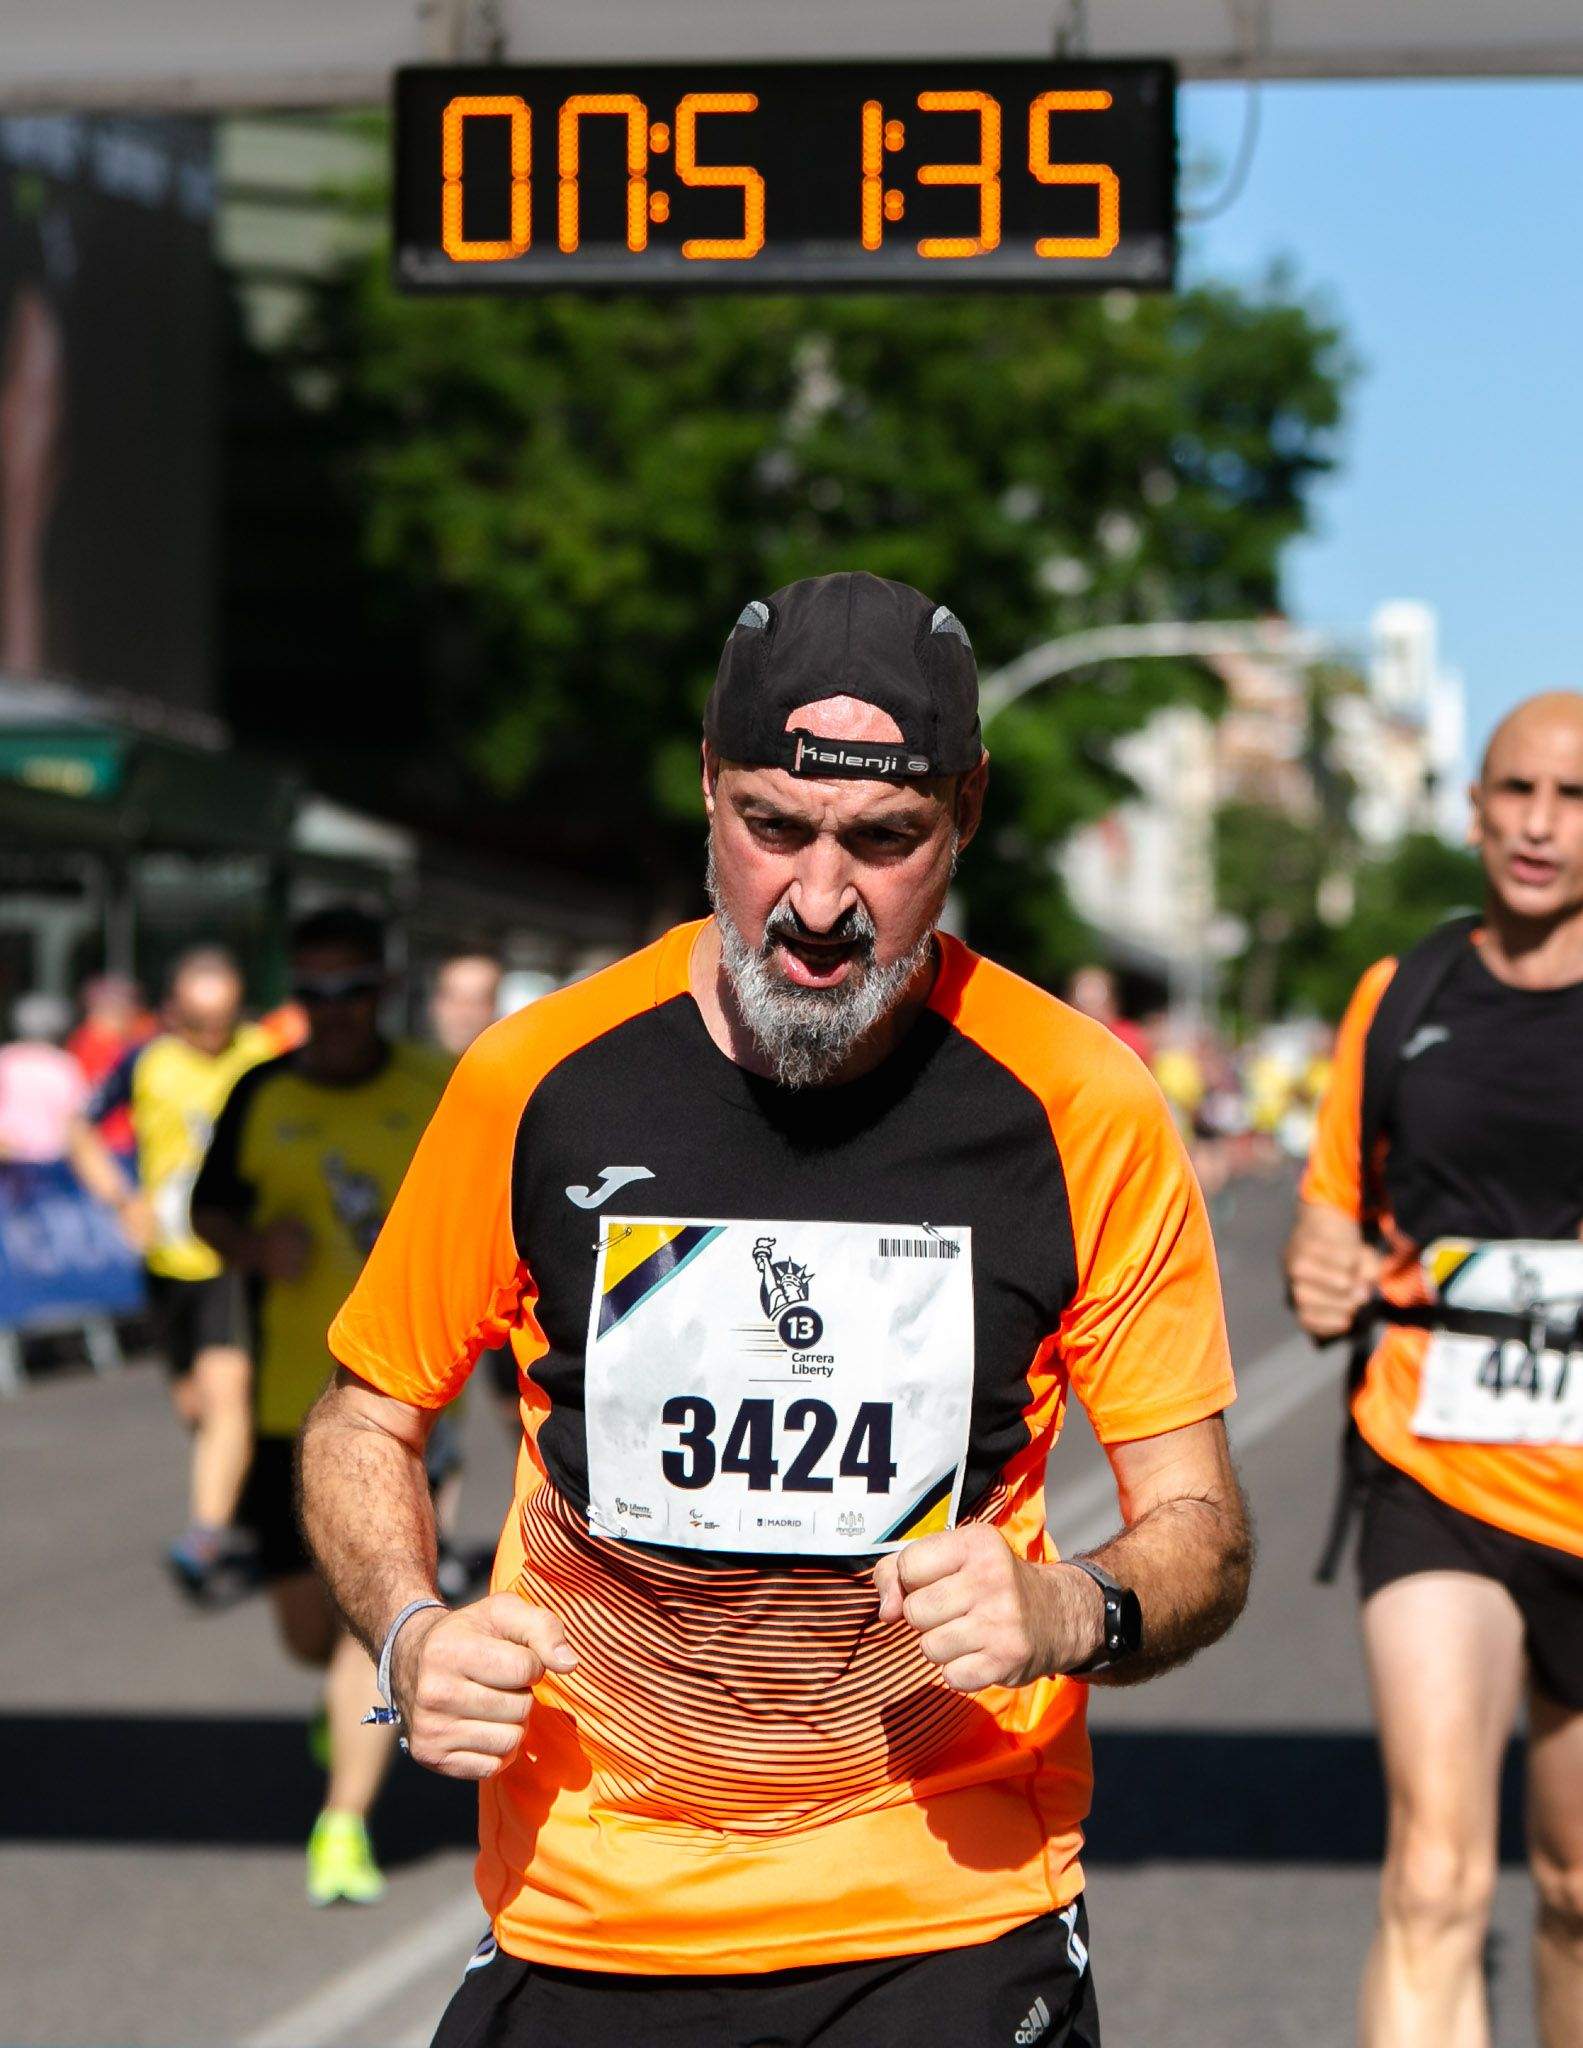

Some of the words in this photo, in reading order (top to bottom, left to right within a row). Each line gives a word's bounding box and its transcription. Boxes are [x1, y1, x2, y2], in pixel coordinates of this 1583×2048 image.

[787, 1316, 814, 1340] 13
[792, 1352, 834, 1363] Carrera
[792, 1364, 834, 1378] Liberty
[661, 1395, 898, 1495] 3424
[767, 1519, 802, 1528] MADRID
